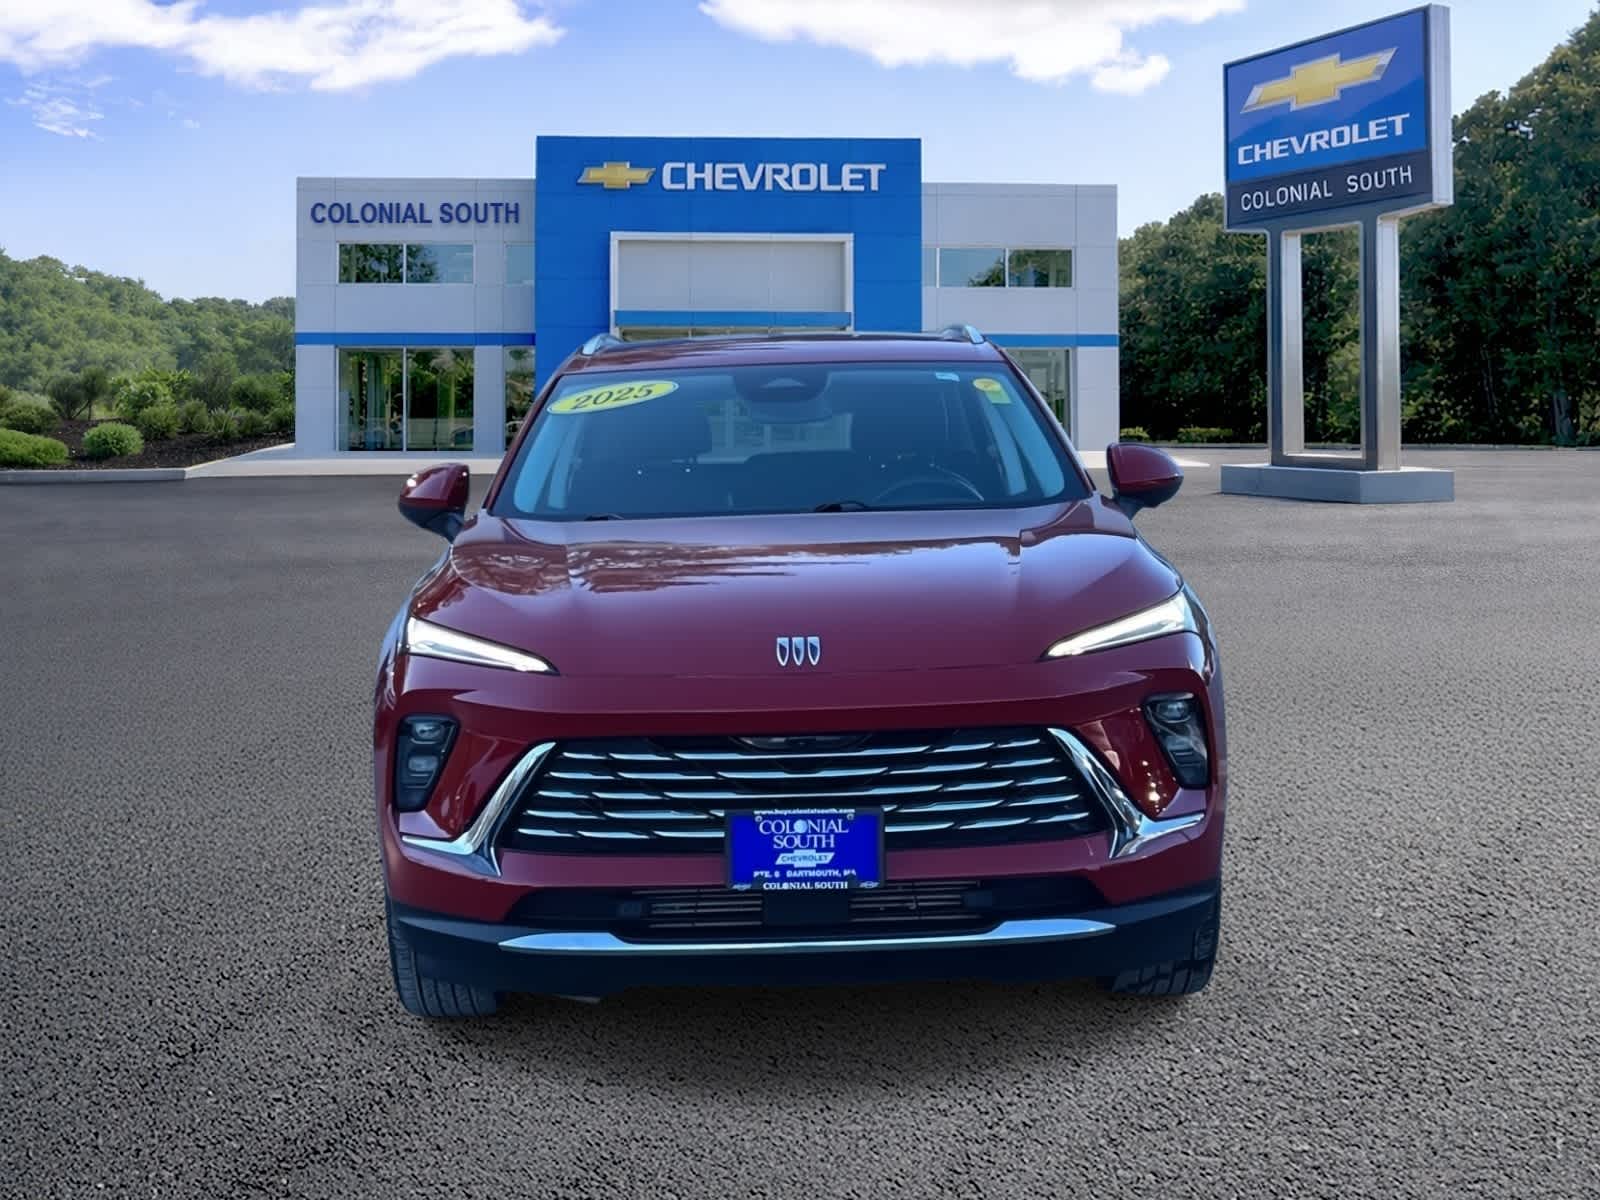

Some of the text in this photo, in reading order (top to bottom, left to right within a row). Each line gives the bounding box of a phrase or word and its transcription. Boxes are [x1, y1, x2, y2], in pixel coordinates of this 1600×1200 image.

[1237, 113, 1410, 165] CHEVROLET
[661, 162, 886, 192] CHEVROLET
[1240, 165, 1412, 211] COLONIAL SOUTH
[310, 202, 521, 225] COLONIAL SOUTH
[571, 384, 656, 410] 2025
[759, 818, 849, 834] COLONIAL
[773, 834, 835, 849] SOUTH
[781, 854, 828, 863] CHEVROLET
[763, 881, 848, 890] COLONIAL SOUTH
